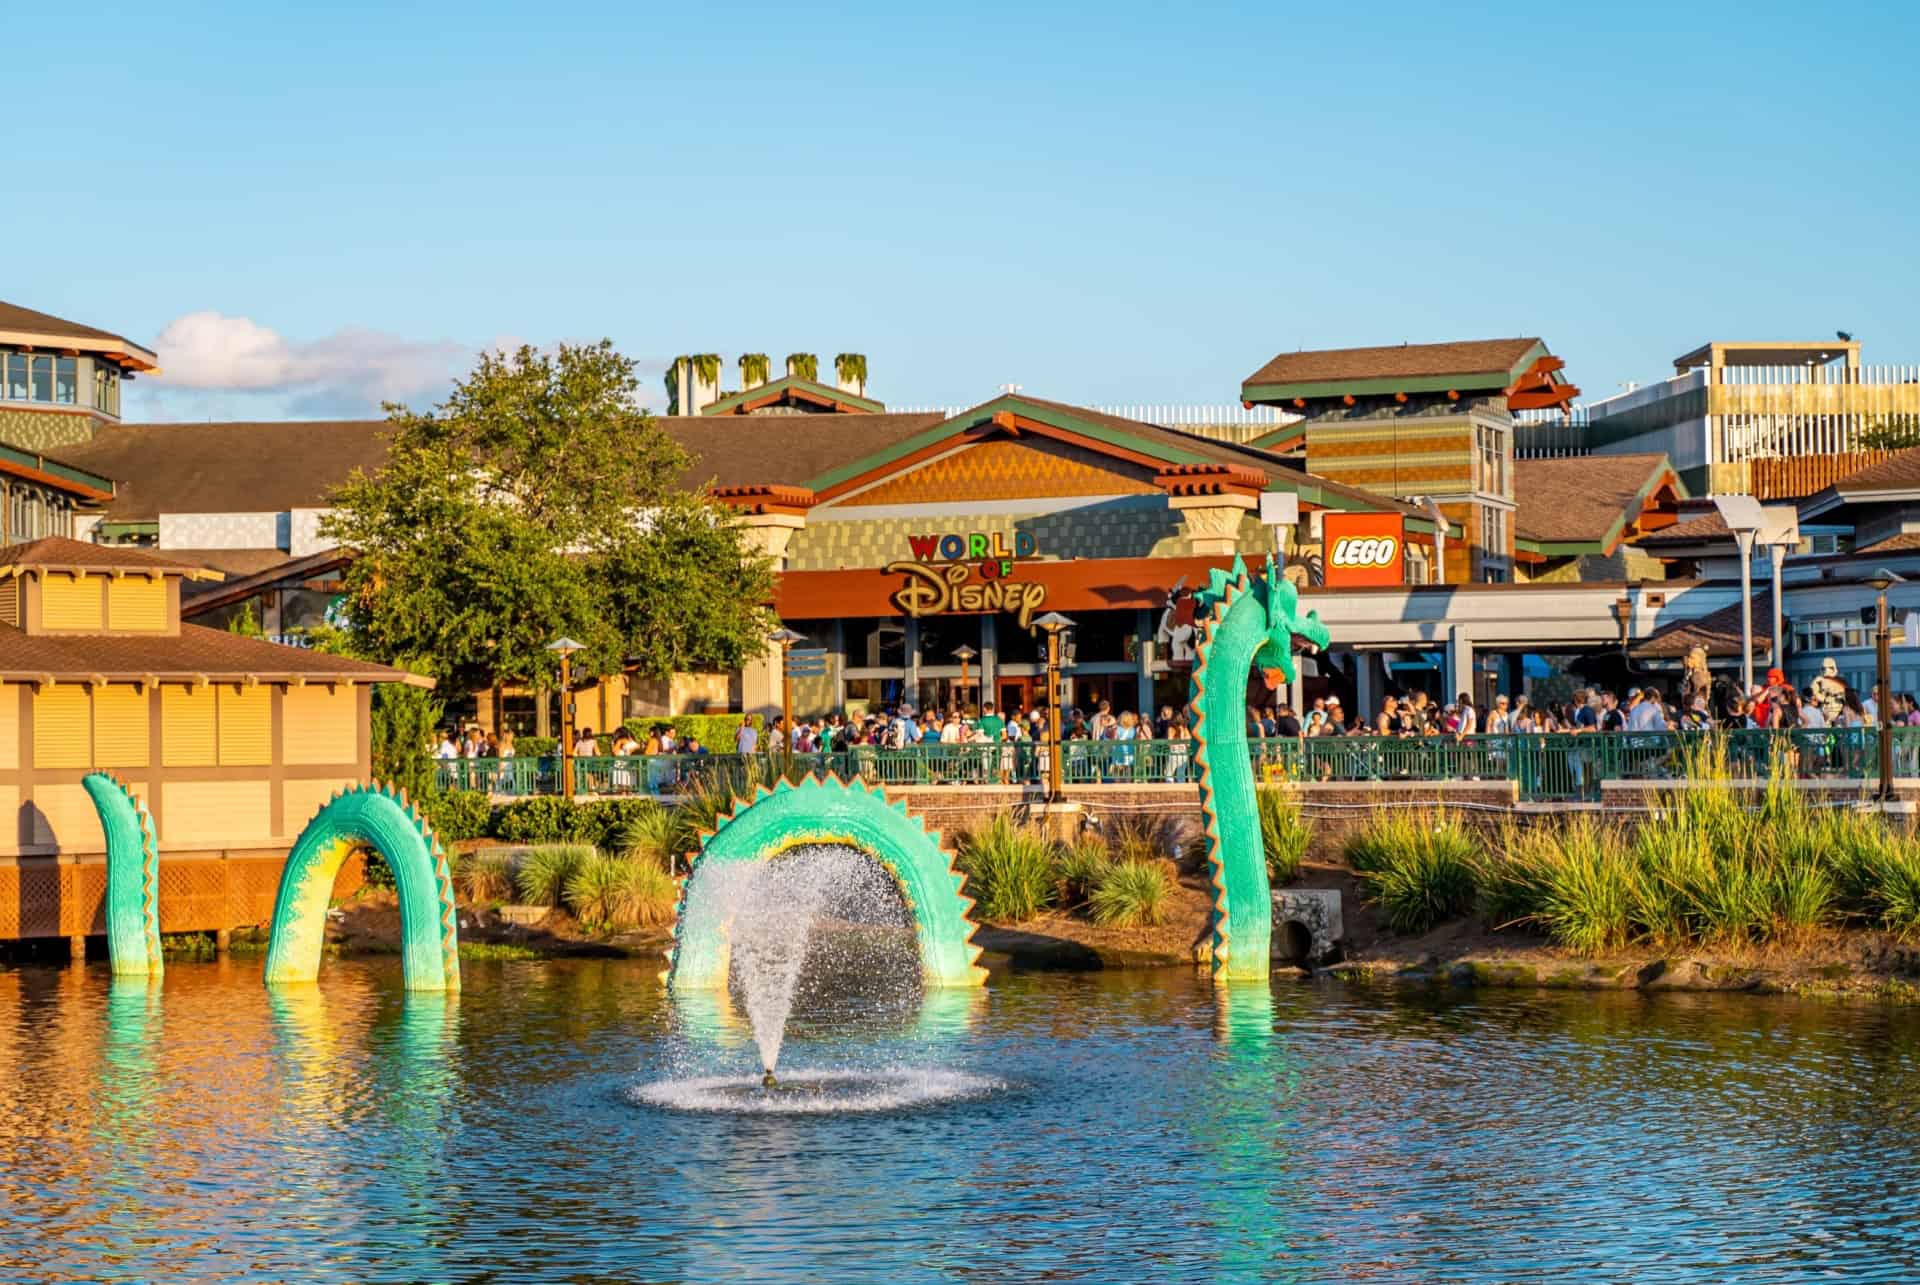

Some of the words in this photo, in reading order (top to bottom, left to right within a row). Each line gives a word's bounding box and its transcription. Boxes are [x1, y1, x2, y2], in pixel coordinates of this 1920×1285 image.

[908, 531, 1036, 561] WORLD
[1332, 538, 1396, 566] LEGO
[980, 559, 1012, 579] OF
